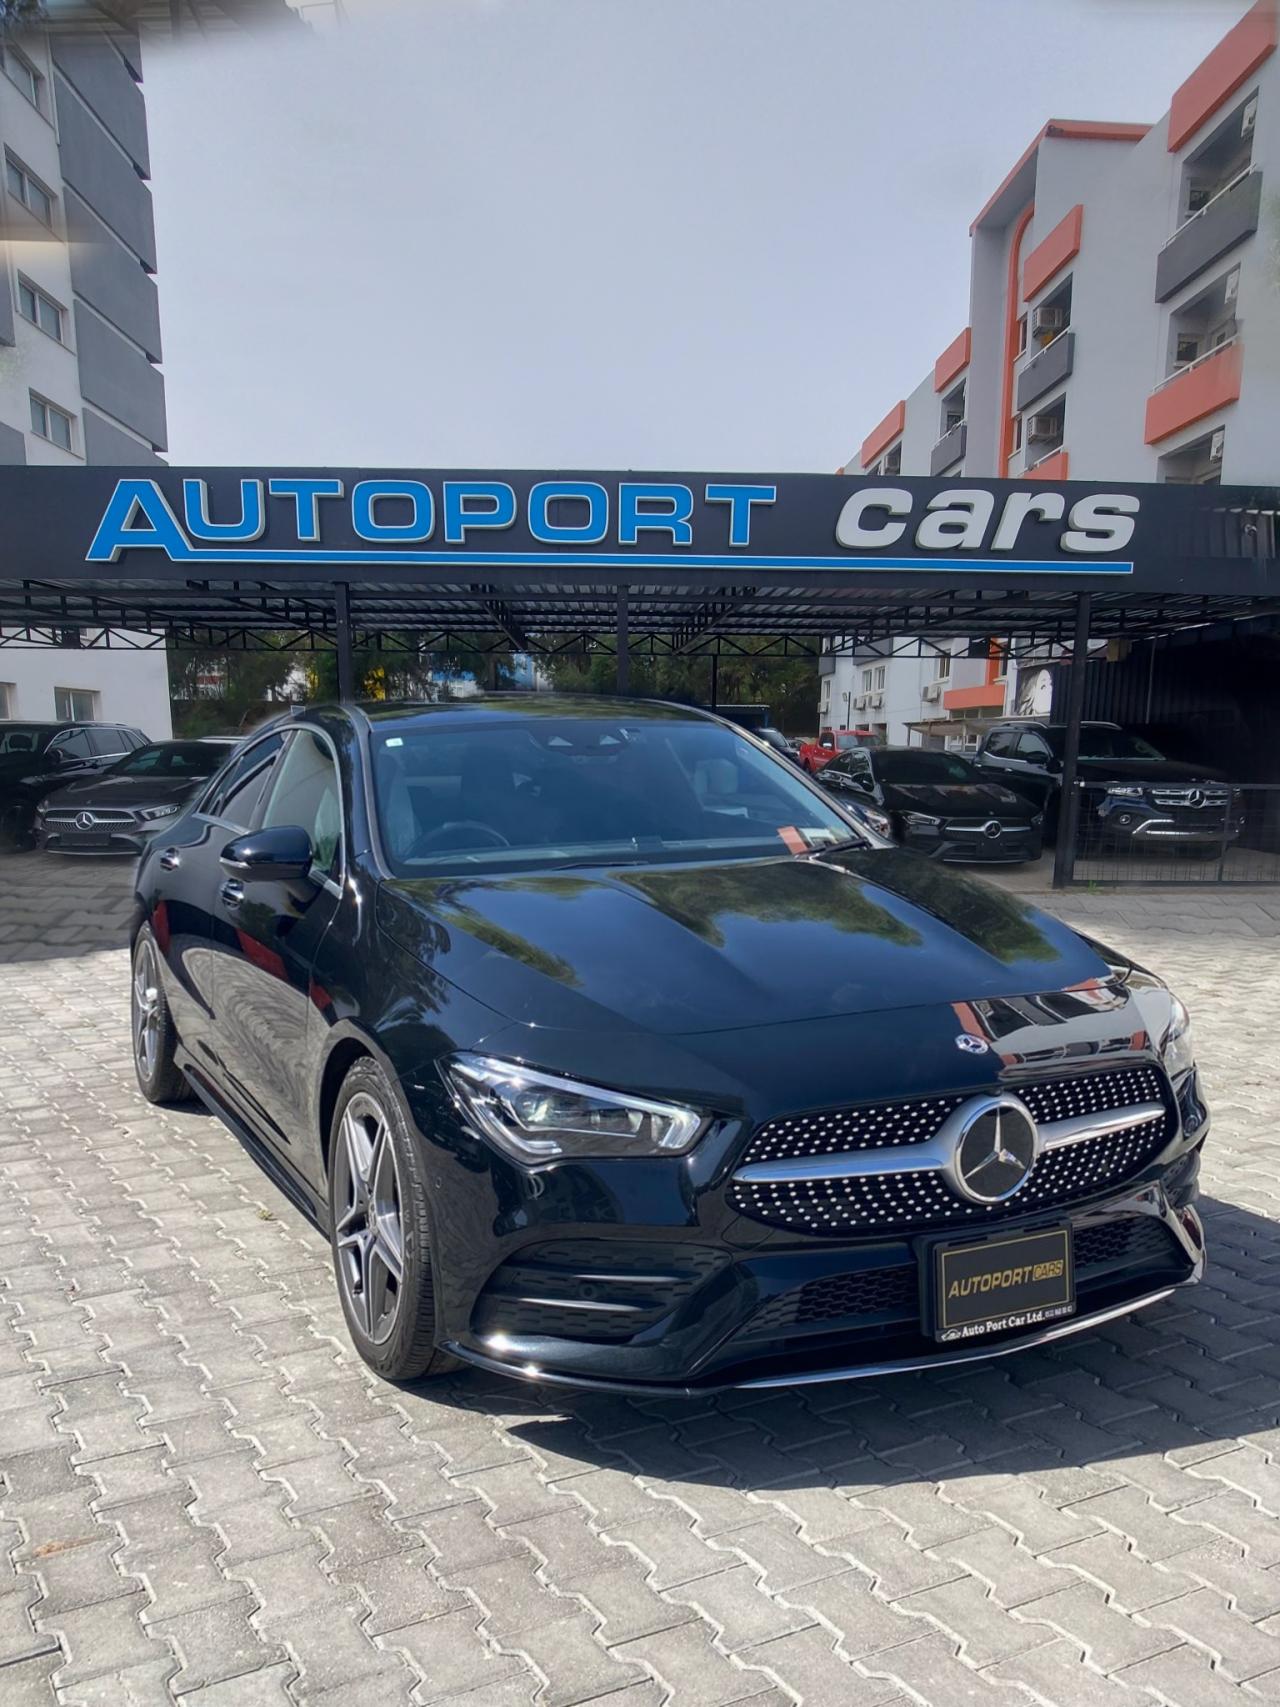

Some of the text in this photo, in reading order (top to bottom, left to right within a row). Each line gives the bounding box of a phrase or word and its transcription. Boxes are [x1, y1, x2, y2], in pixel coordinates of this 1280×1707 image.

[85, 477, 1141, 565] AUTOPORT cars
[948, 1260, 1064, 1299] AUTOPORT CARS
[962, 1325, 985, 1338] Auto
[986, 1319, 1008, 1333] Port
[1008, 1316, 1026, 1328] Car
[1026, 1311, 1046, 1325] Ltd.
